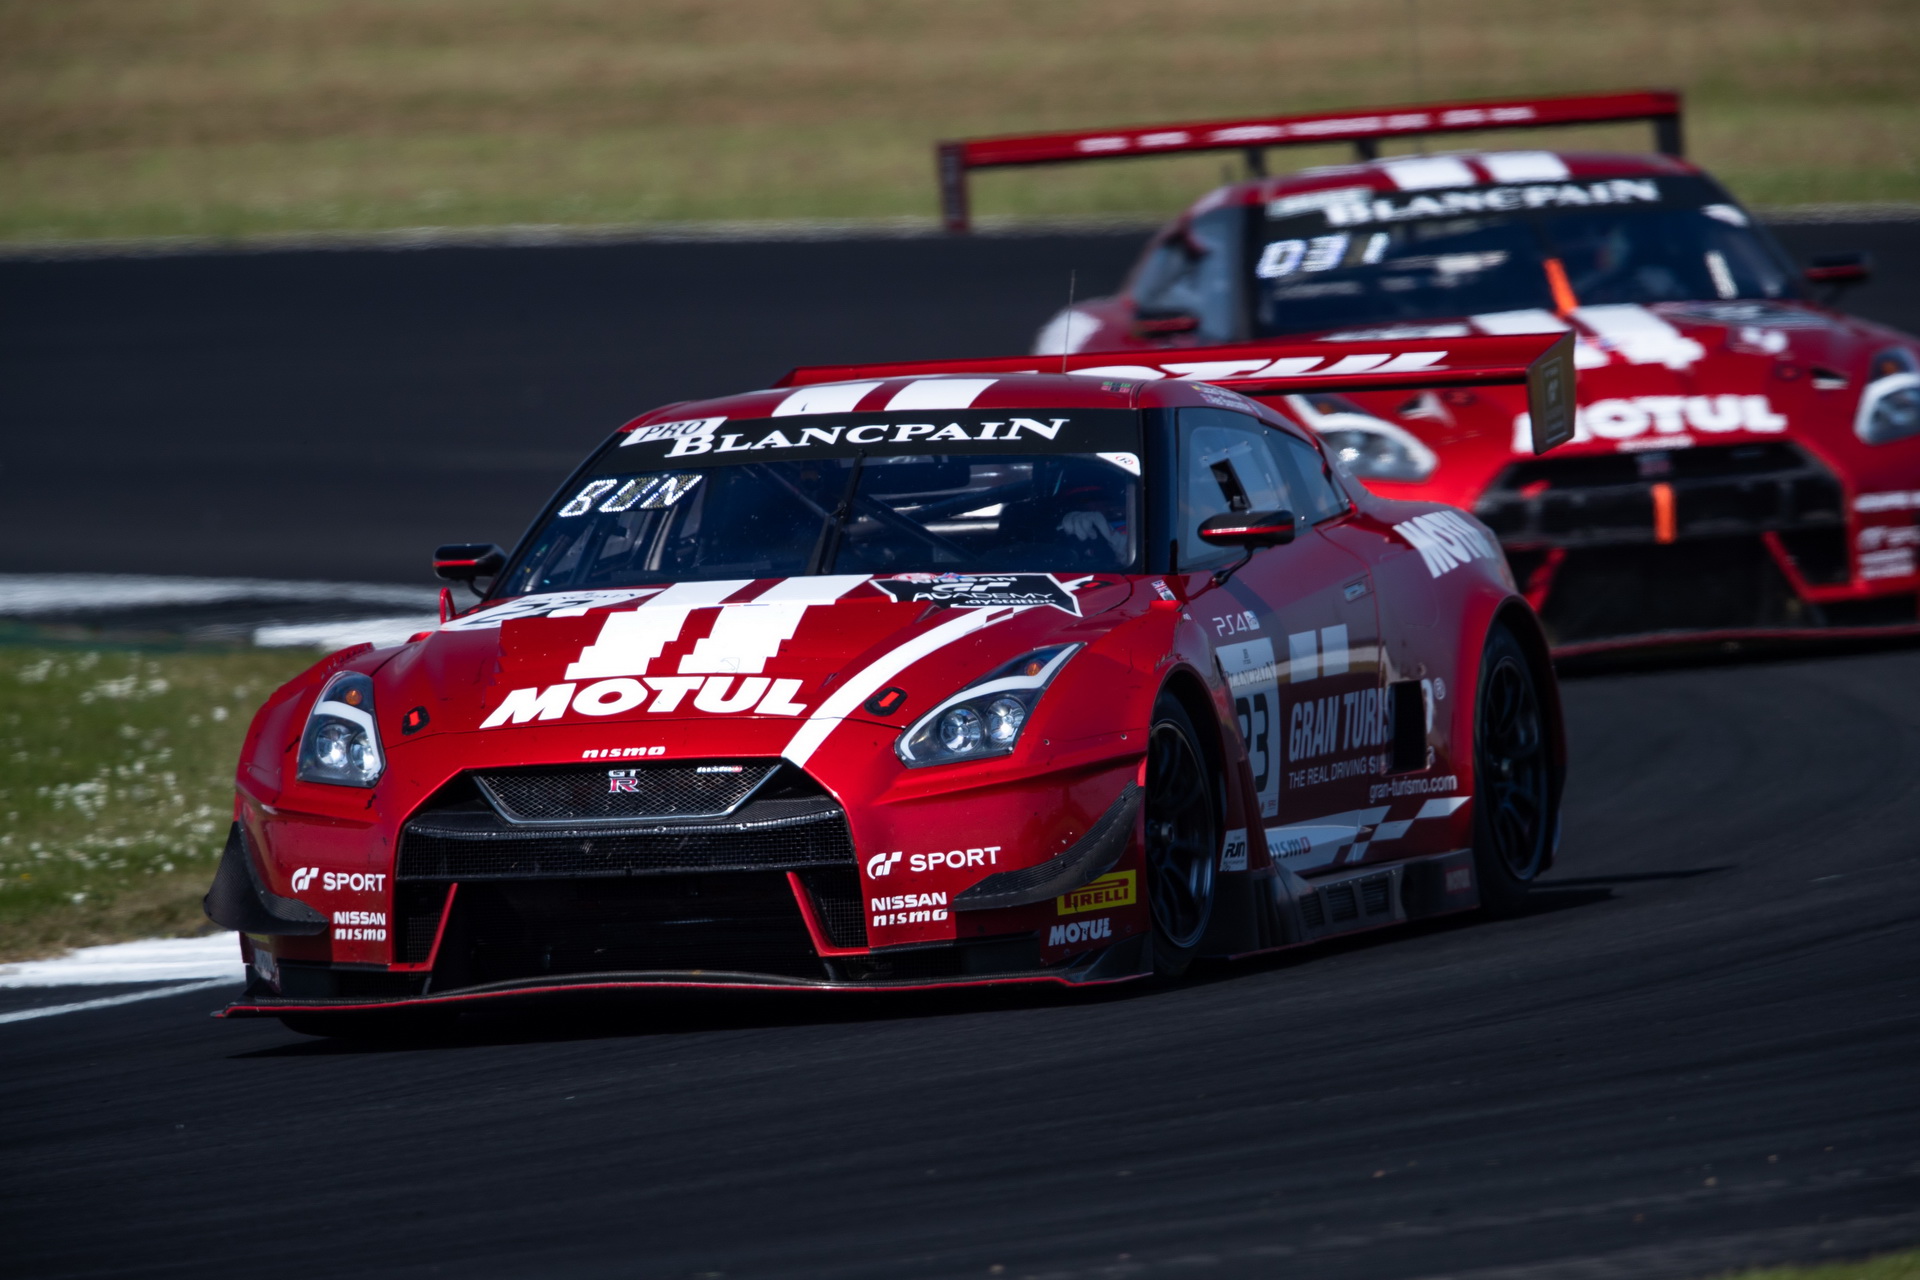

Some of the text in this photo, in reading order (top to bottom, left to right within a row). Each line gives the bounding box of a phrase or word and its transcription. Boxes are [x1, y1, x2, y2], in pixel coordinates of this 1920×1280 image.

[1006, 351, 1447, 381] OTUL
[638, 420, 708, 441] PRO
[663, 418, 1070, 458] BLANCPAIN
[479, 676, 808, 730] MOTUL
[1289, 694, 1340, 763] GRAN
[582, 745, 666, 758] nismo
[1288, 770, 1306, 790] THE
[1307, 765, 1330, 786] REAL
[1331, 756, 1368, 781] DRIVING
[910, 846, 1001, 872] SPORT
[323, 873, 386, 892] SPORT
[1064, 879, 1129, 909] PIRELLI
[871, 891, 947, 912] NISSAN
[333, 911, 386, 927] NISSAN
[873, 908, 948, 927] nismo
[335, 928, 387, 942] nismo
[1048, 917, 1112, 947] MOTUL
